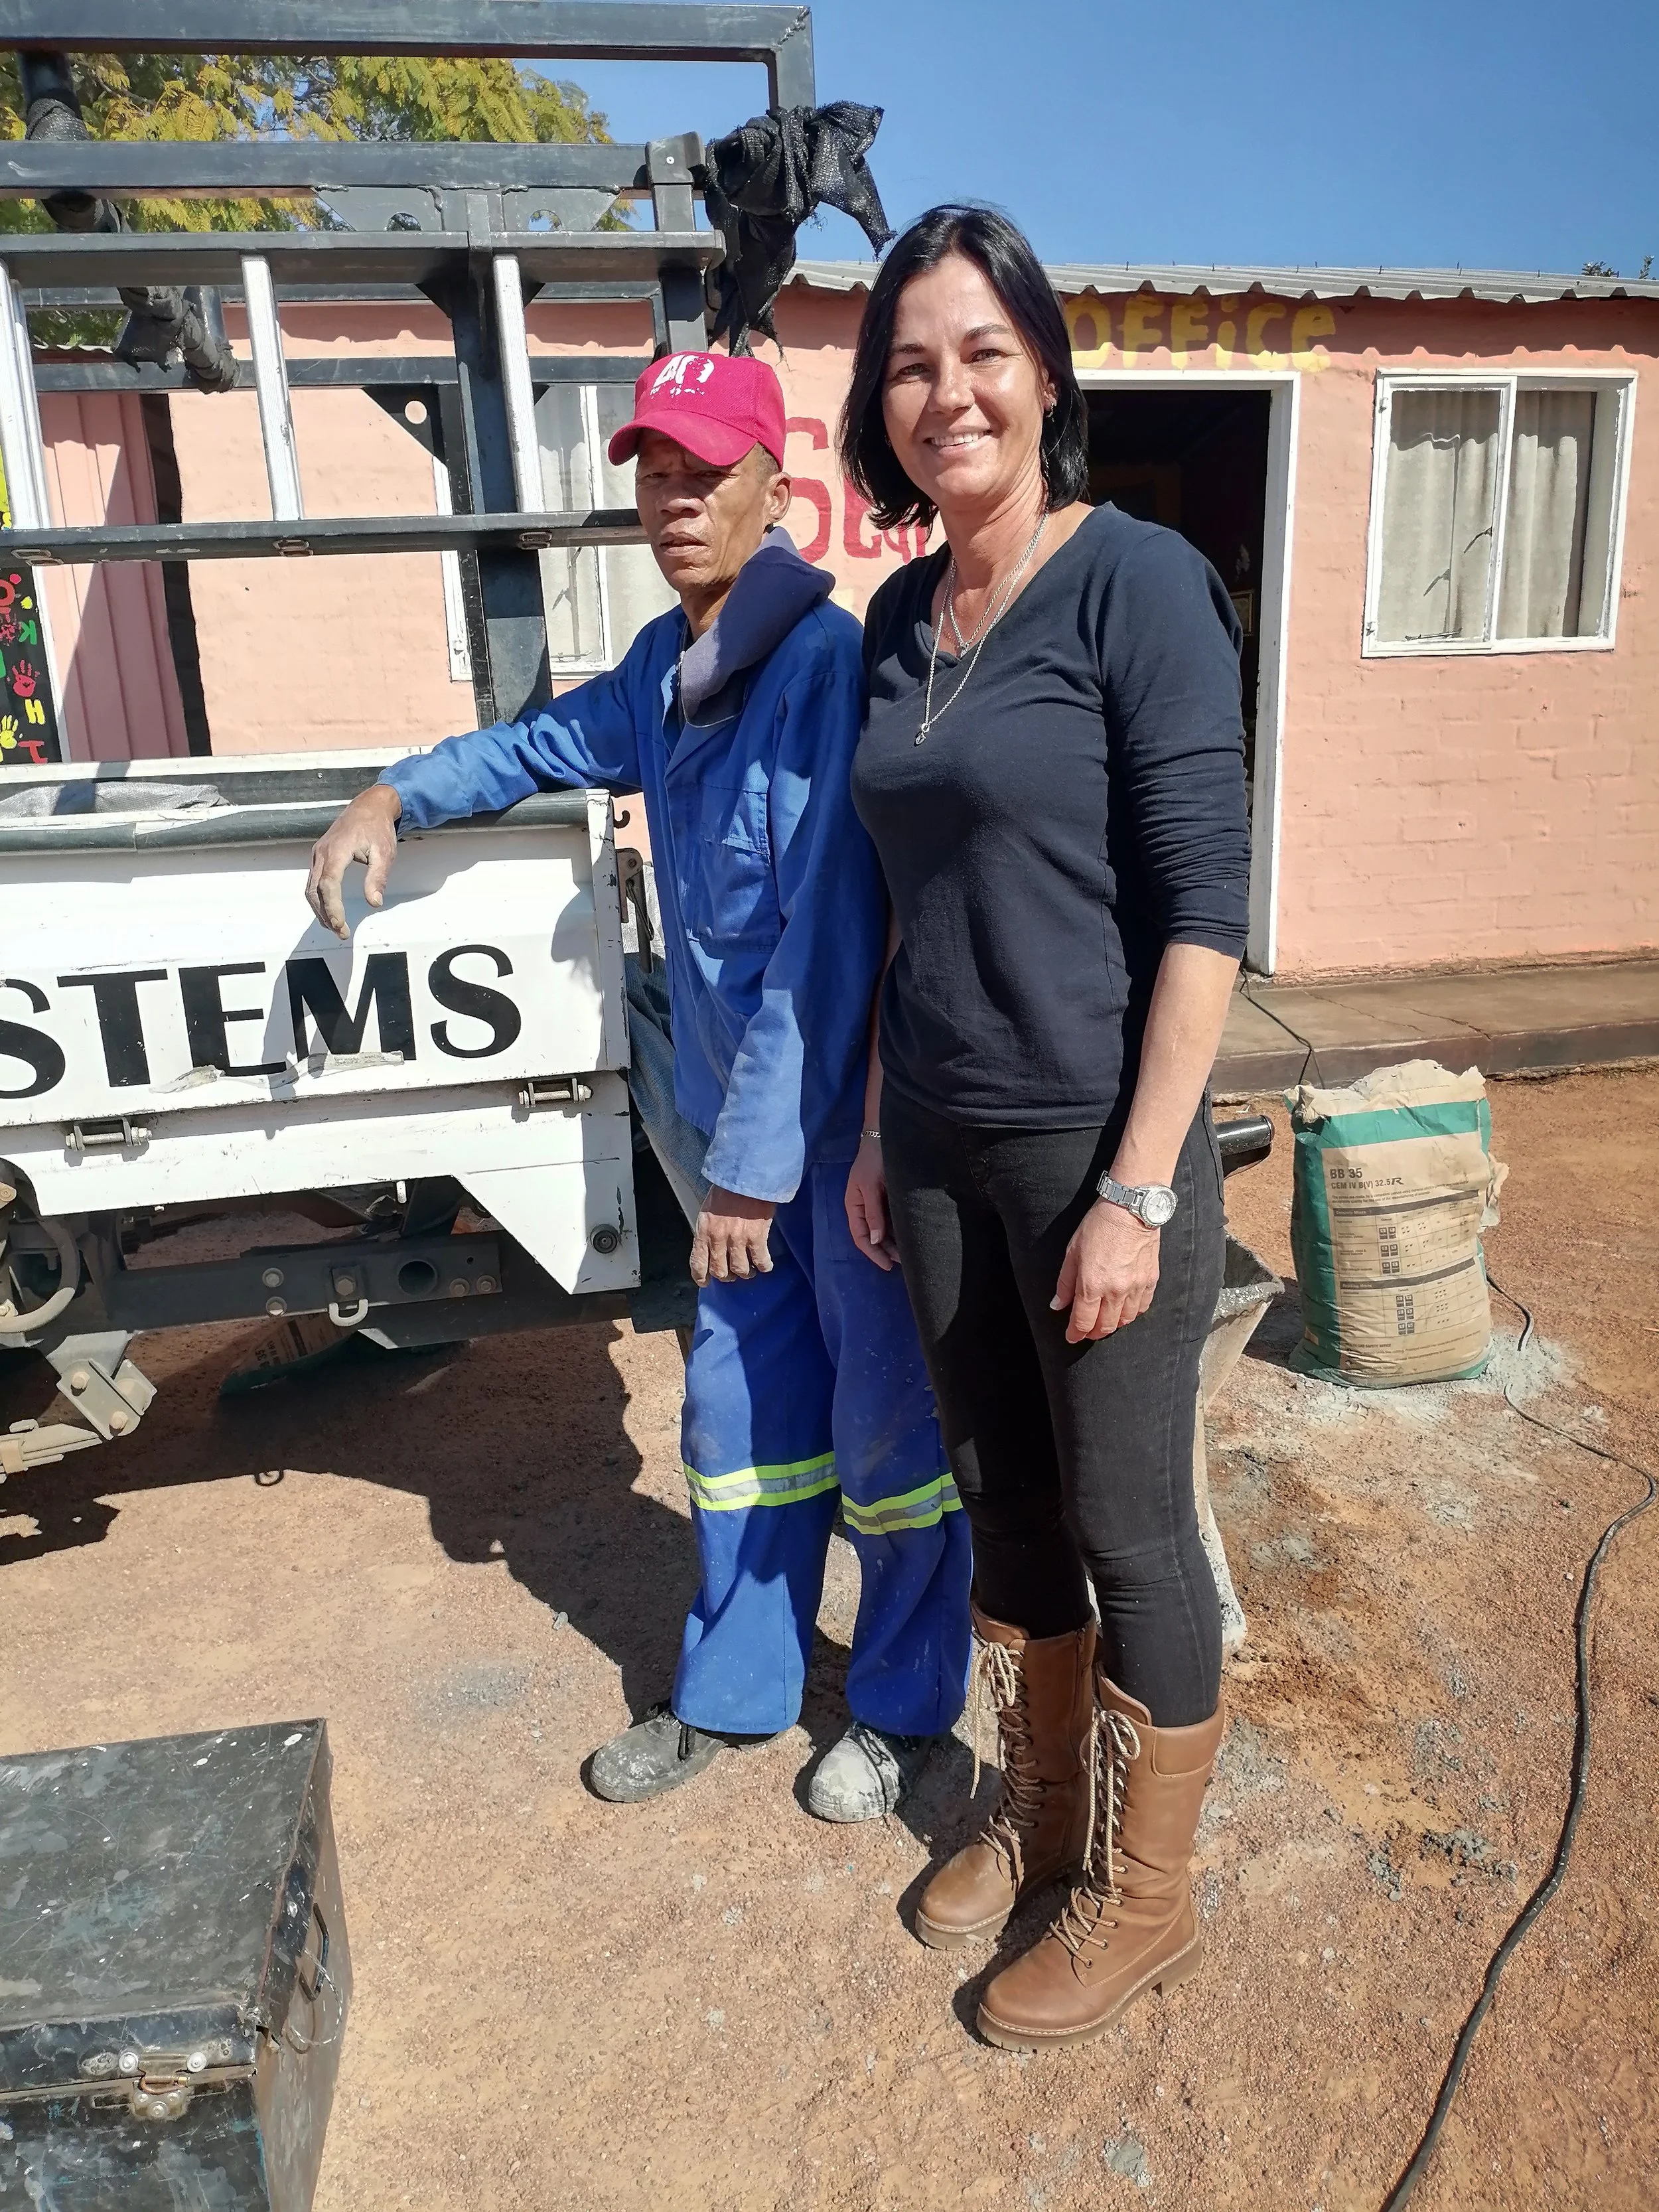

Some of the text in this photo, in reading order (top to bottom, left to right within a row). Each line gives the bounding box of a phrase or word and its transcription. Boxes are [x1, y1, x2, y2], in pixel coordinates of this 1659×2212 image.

[0, 944, 522, 1099] STEMS
[1330, 1168, 1362, 1179] BB 35
[1359, 1181, 1373, 1189] B(V)
